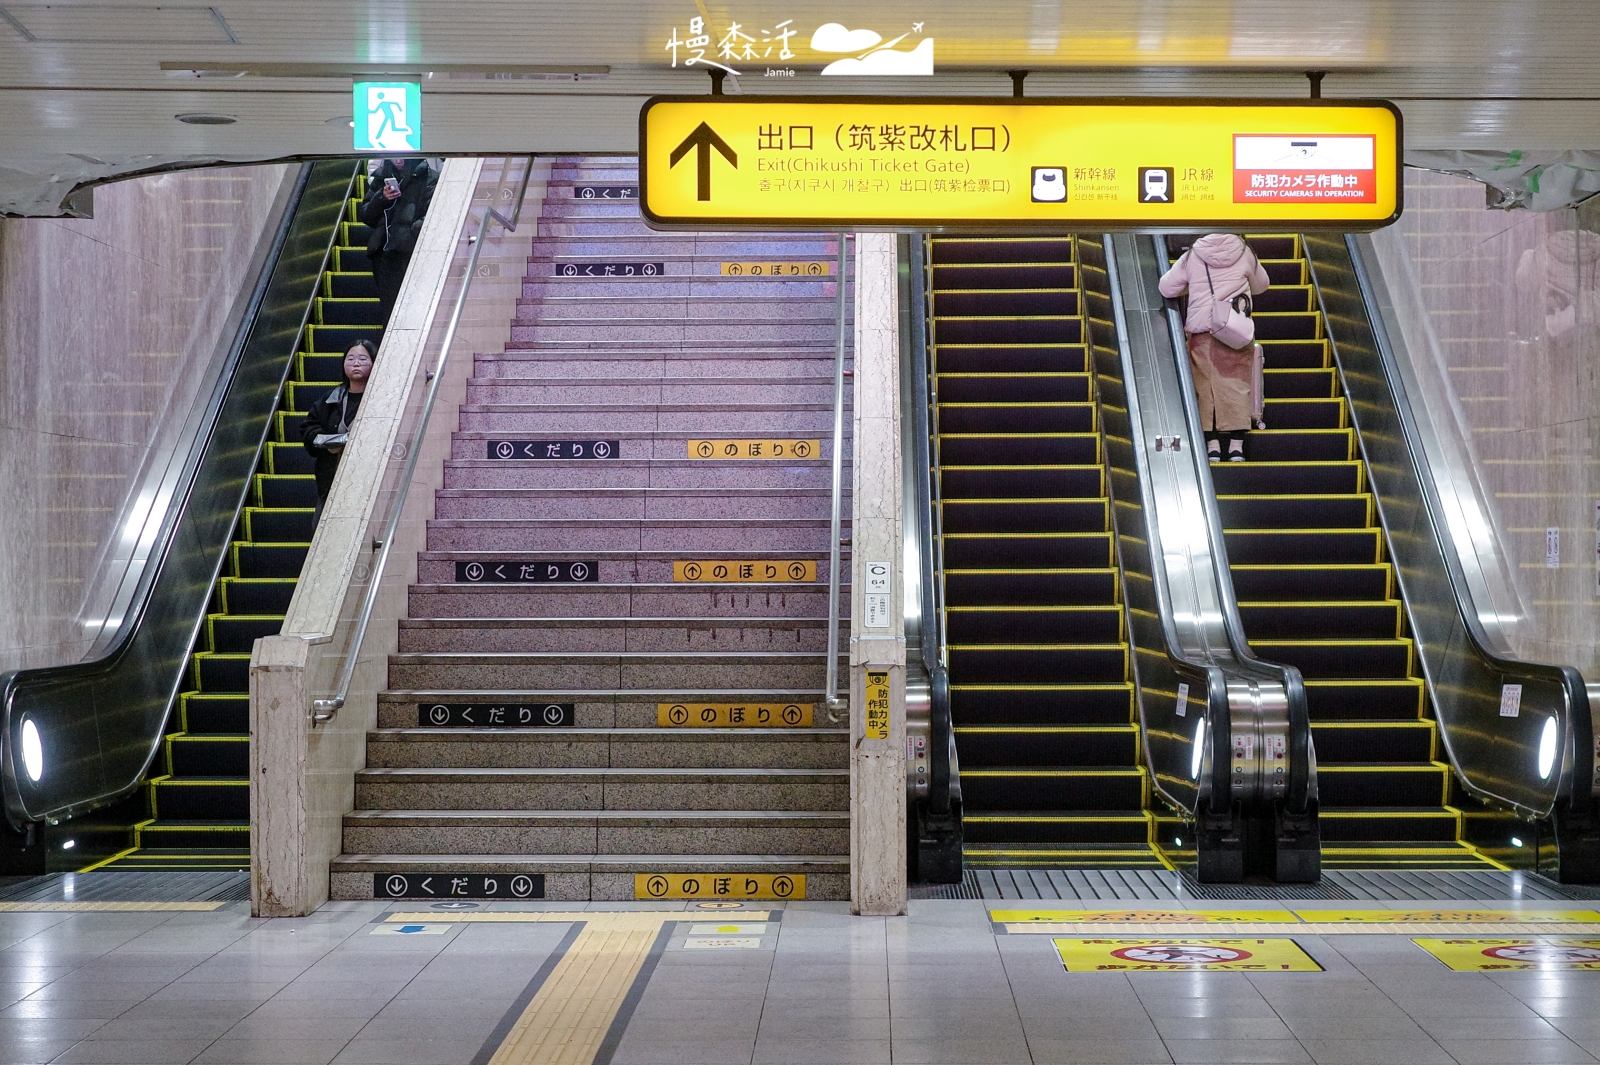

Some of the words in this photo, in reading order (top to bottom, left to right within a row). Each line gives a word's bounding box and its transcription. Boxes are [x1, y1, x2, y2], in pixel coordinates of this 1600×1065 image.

[757, 157, 863, 174] Exit(Chikushi
[869, 158, 919, 173] Ticket
[925, 158, 971, 174] Gate)
[1074, 167, 1116, 181] 新幹線
[1251, 174, 1358, 188] 防犯カメラ作動中
[602, 188, 632, 198] くだ
[758, 178, 835, 193] 출구(지쿠시
[841, 178, 891, 193] 개찰구)
[1073, 183, 1120, 191] Shinkansen
[1181, 184, 1190, 192] JR
[1192, 184, 1209, 192] Line
[585, 264, 635, 276] くだり
[750, 264, 801, 276] のぼり
[524, 441, 584, 458] くだり
[724, 441, 785, 457] のぼり
[495, 564, 560, 581] くだり
[713, 564, 778, 580] のぼり
[870, 566, 887, 575] C
[461, 706, 532, 724] くだり
[700, 706, 771, 724] のぼり
[868, 699, 878, 730] 作動中
[877, 689, 889, 740] 防犯カメラ
[421, 876, 499, 895] くだり
[682, 876, 759, 895] のぼり
